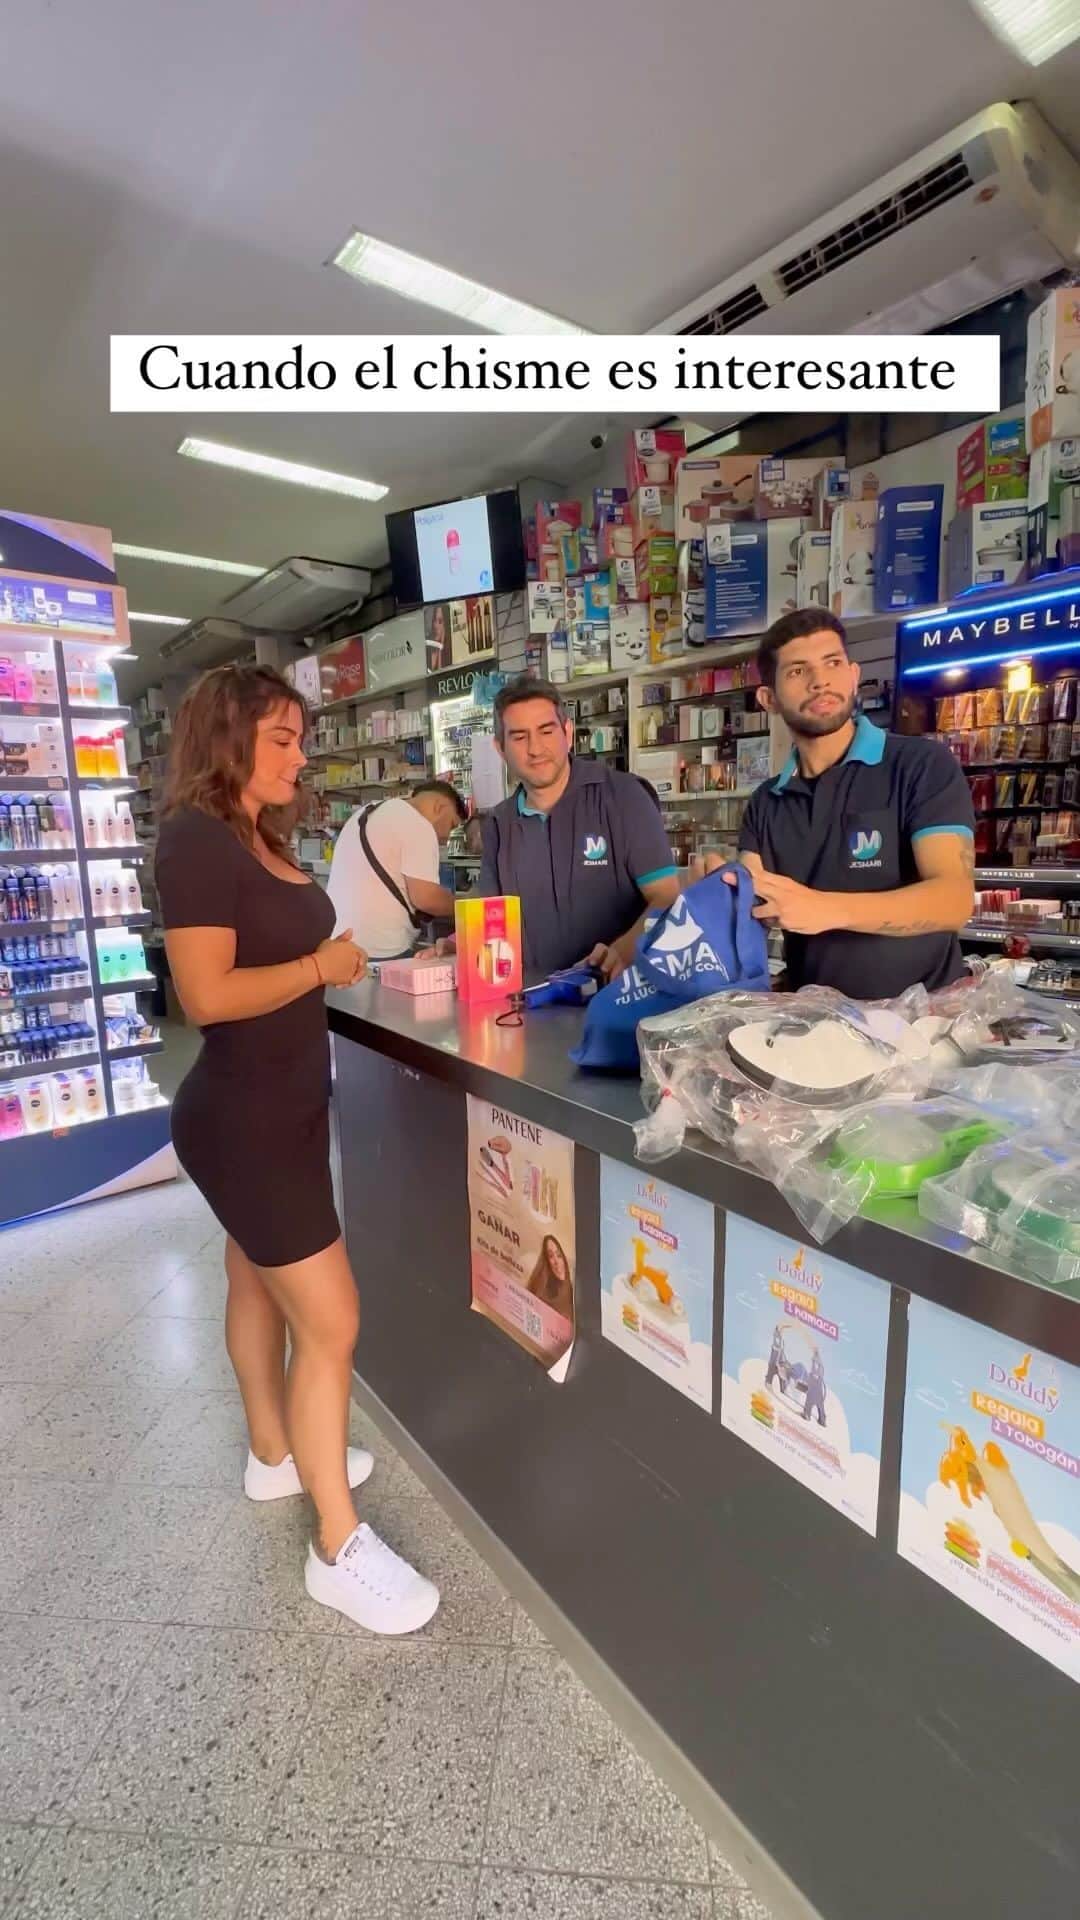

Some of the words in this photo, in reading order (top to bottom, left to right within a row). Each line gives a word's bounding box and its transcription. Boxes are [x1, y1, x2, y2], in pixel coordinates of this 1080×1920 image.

[491, 1107, 543, 1146] PANTENE
[477, 1209, 520, 1248] GANAR
[778, 1256, 822, 1293] Doddy
[989, 1363, 1059, 1414] Doddy
